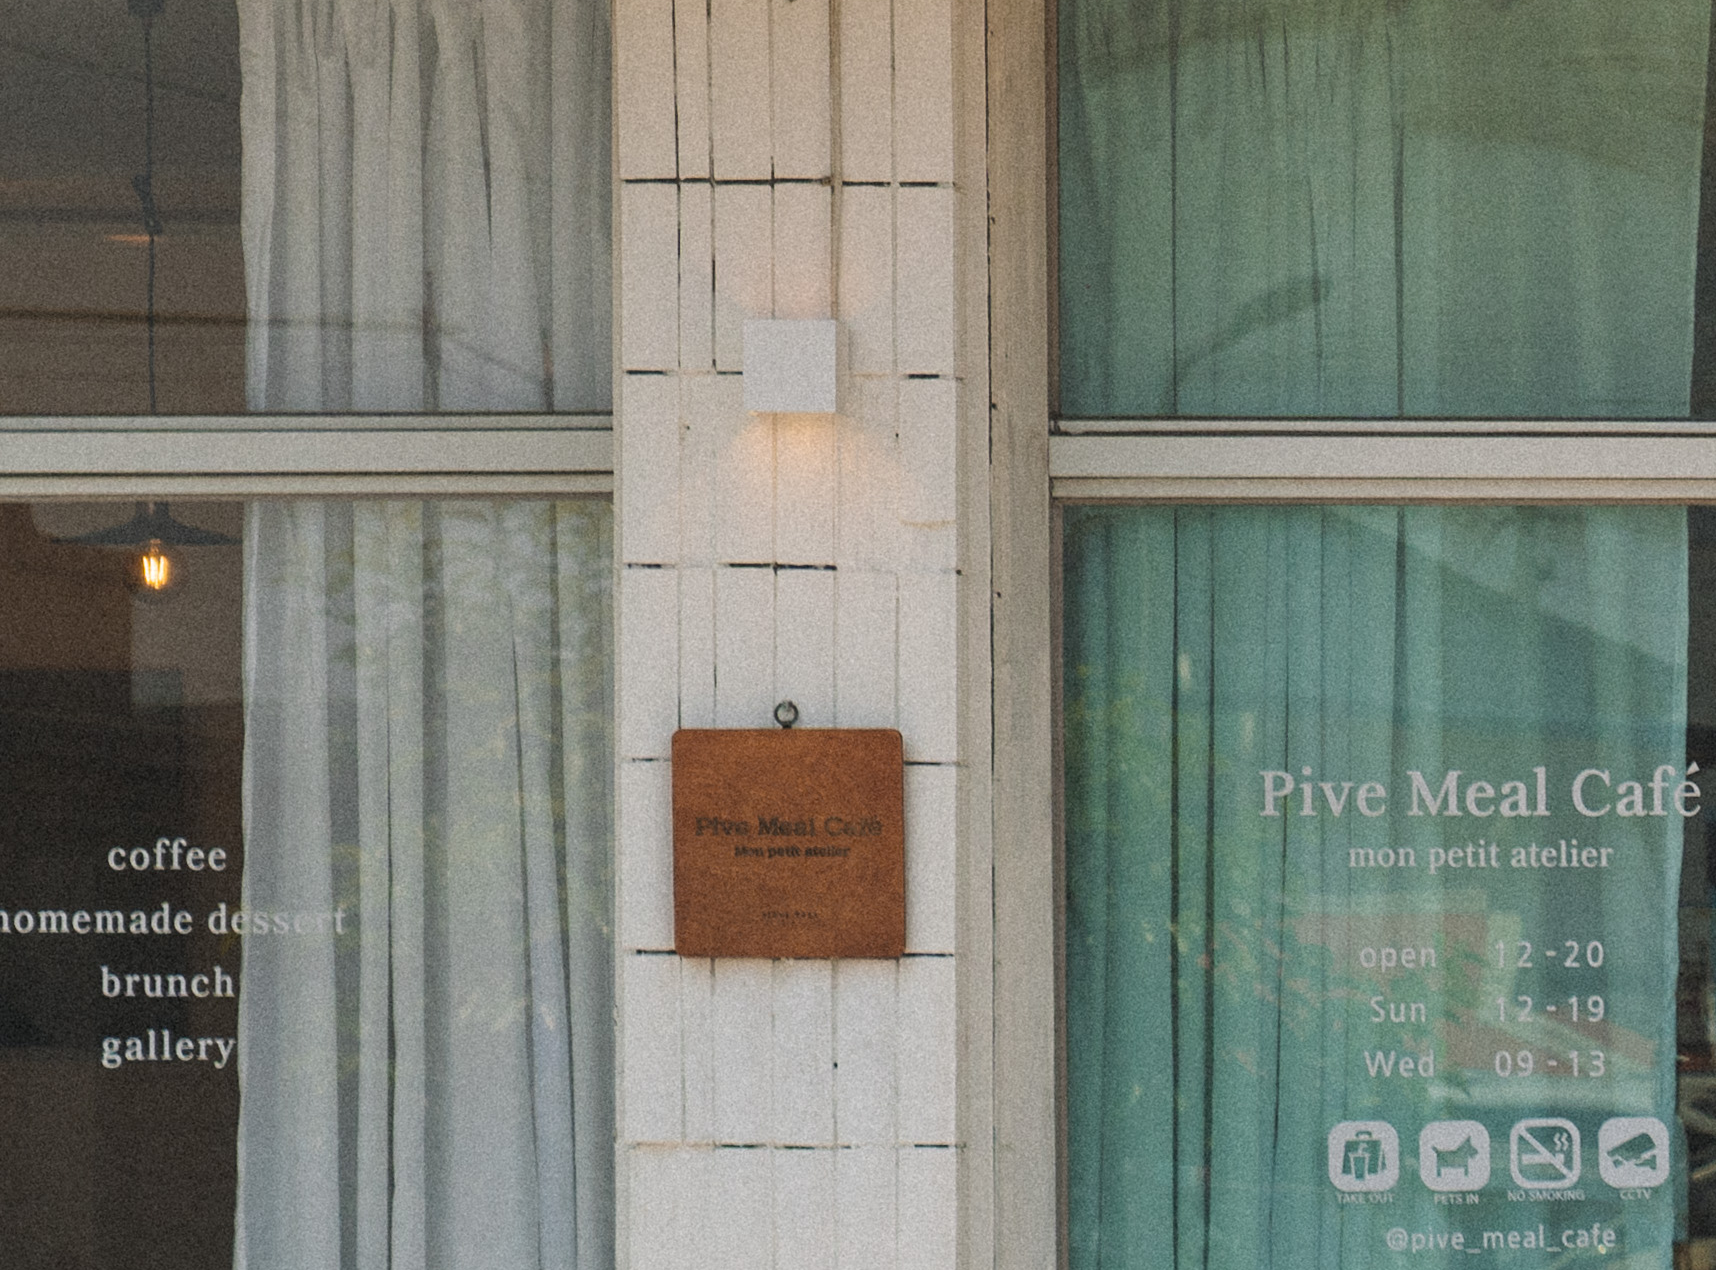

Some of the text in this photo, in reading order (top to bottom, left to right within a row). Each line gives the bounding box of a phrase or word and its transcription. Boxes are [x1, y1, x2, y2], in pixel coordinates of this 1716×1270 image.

[1258, 761, 1702, 818] Pive Meal Café
[106, 836, 228, 872] coffee
[1348, 839, 1614, 875] mon petit atelier
[207, 901, 348, 935] dessert
[1358, 944, 1438, 975] open
[100, 964, 236, 998] brunch
[1369, 995, 1428, 1023] Sun
[100, 1028, 237, 1070] gallery
[1364, 1049, 1436, 1078] Wed
[1336, 1193, 1395, 1205] TAKE OUT
[1433, 1194, 1480, 1205] PETS IN
[1507, 1189, 1586, 1202] NO SMOKING
[1619, 1189, 1652, 1201] CCTV
[1385, 1223, 1618, 1255] @pive_meal_cafe
